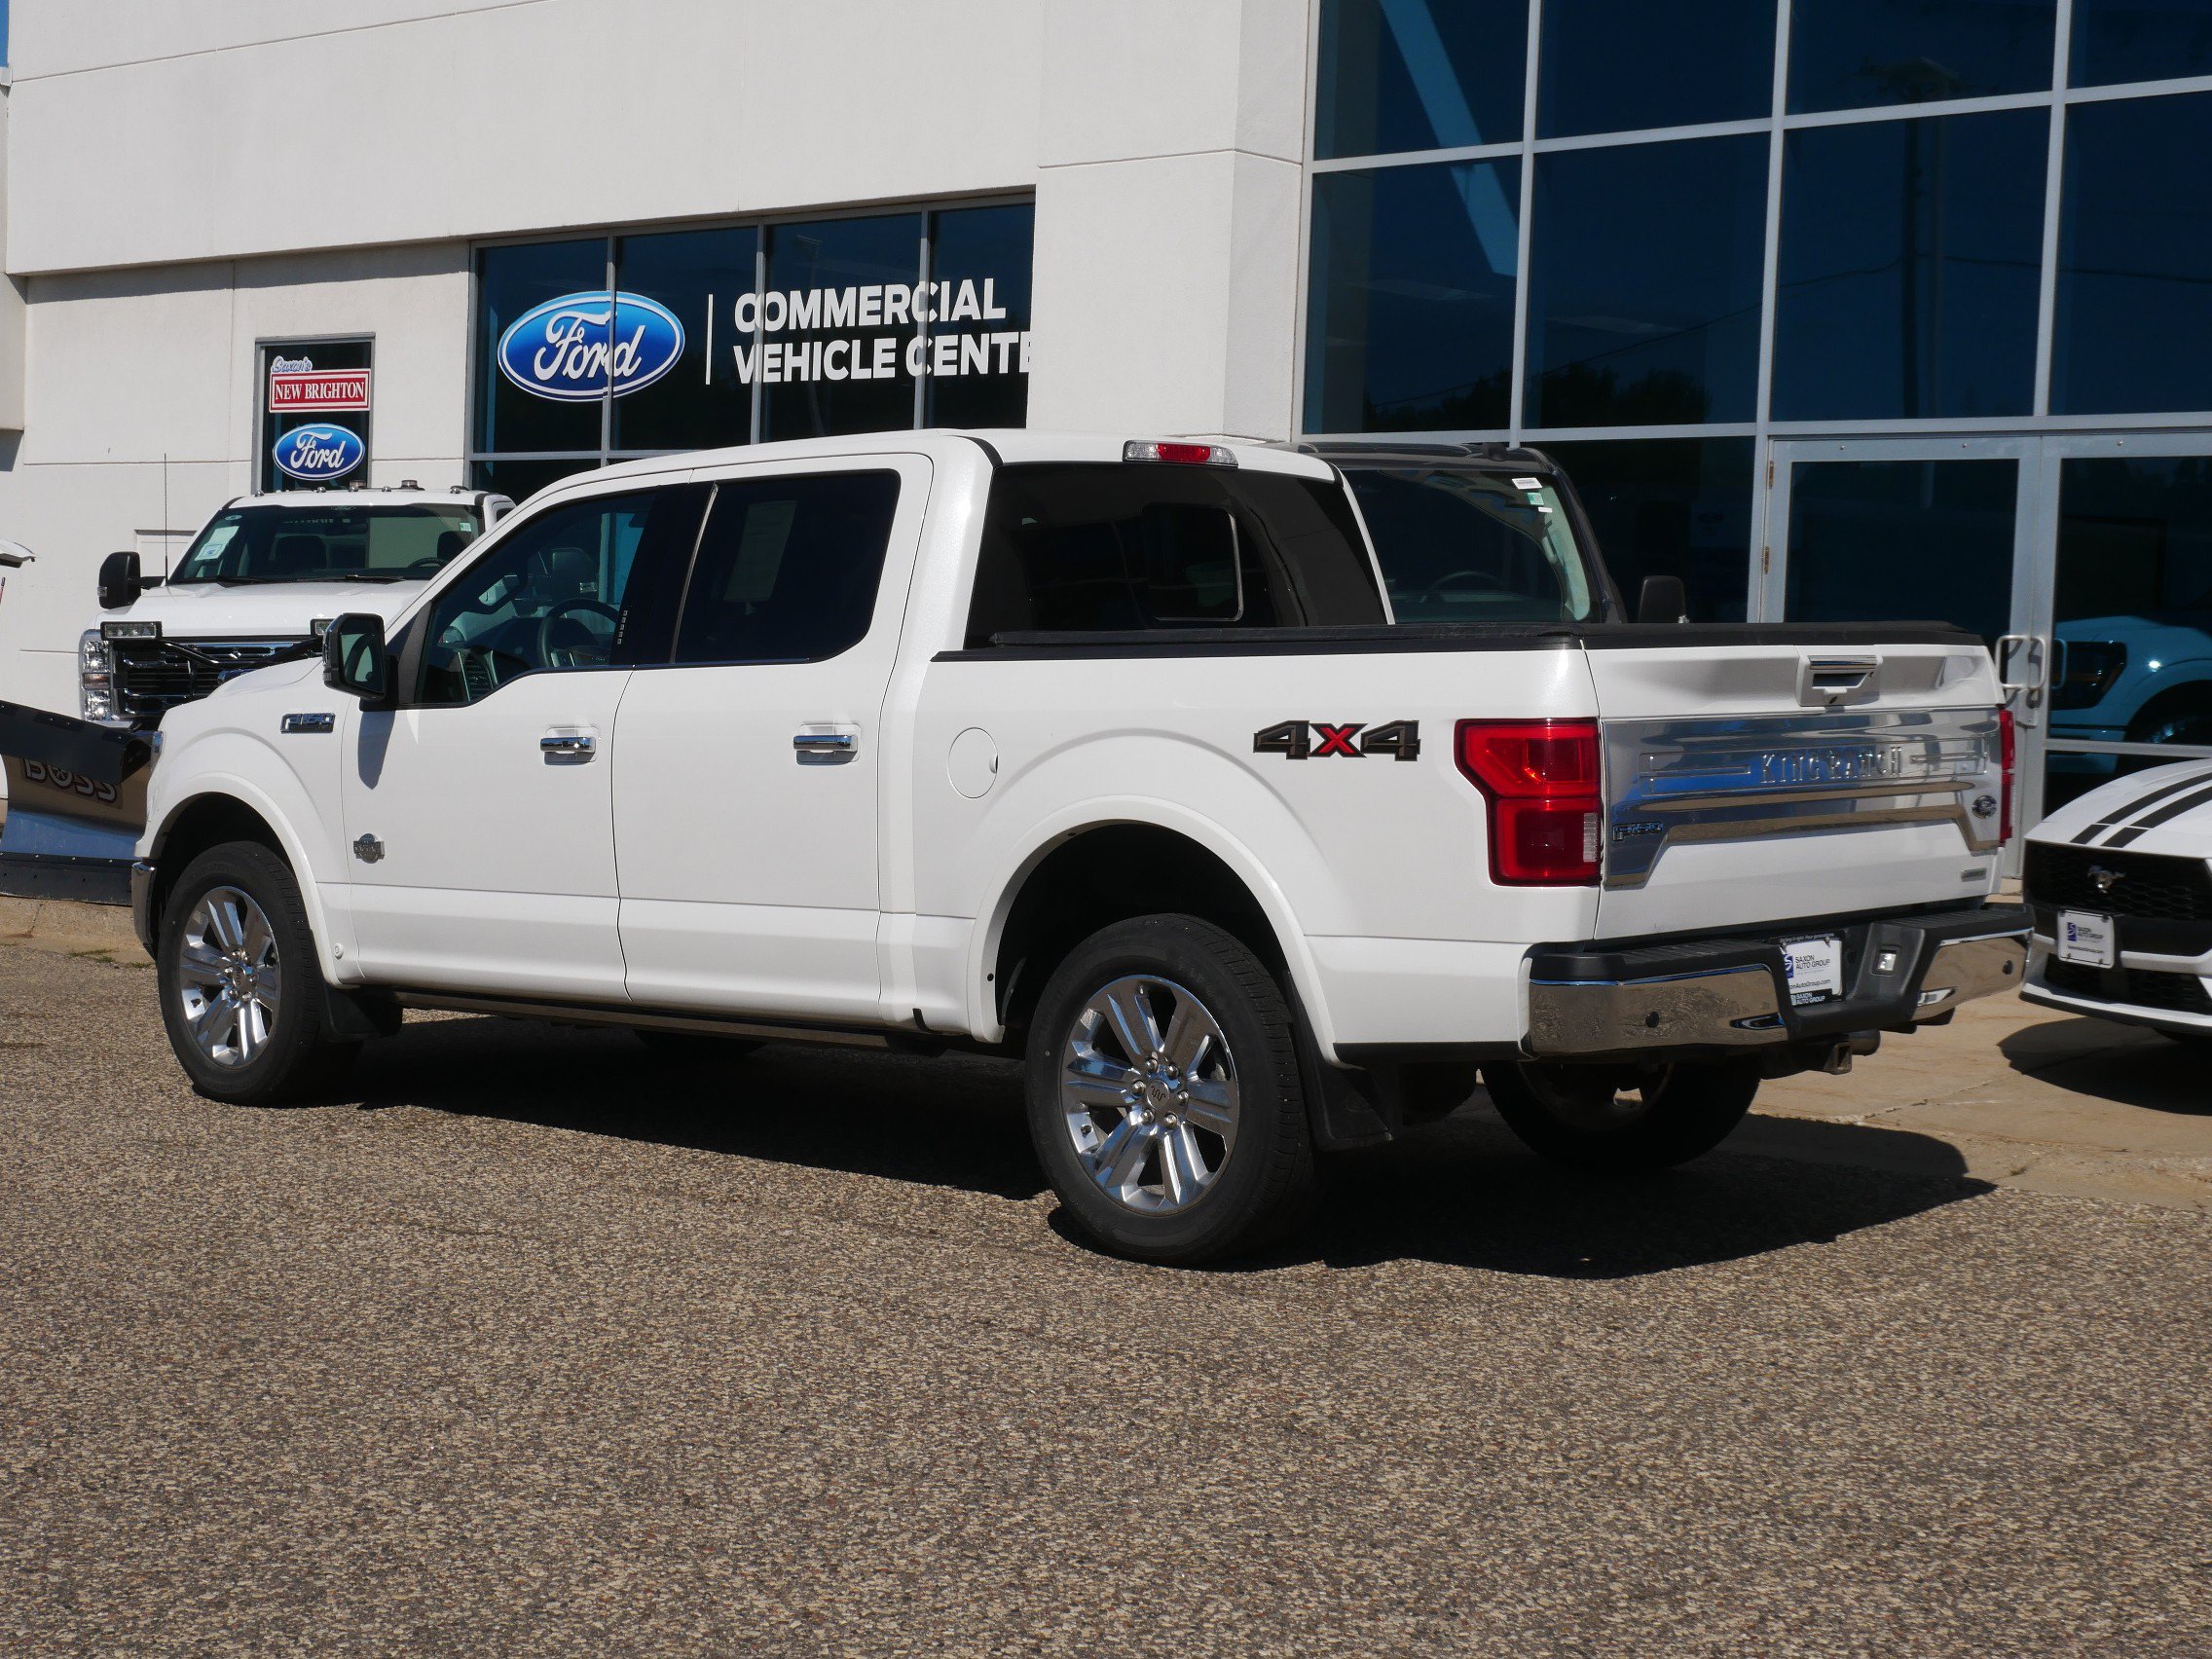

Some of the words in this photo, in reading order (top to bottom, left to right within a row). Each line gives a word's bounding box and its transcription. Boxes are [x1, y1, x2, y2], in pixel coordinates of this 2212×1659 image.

[735, 278, 1007, 333] COMMERCIAL
[272, 355, 313, 373] Saxon's
[535, 311, 645, 381] Ford
[733, 338, 897, 385] VEHICLE
[276, 383, 303, 400] NEW
[305, 381, 365, 399] BRIGHTON
[290, 431, 347, 469] Ford
[1812, 958, 1829, 967] GROUP
